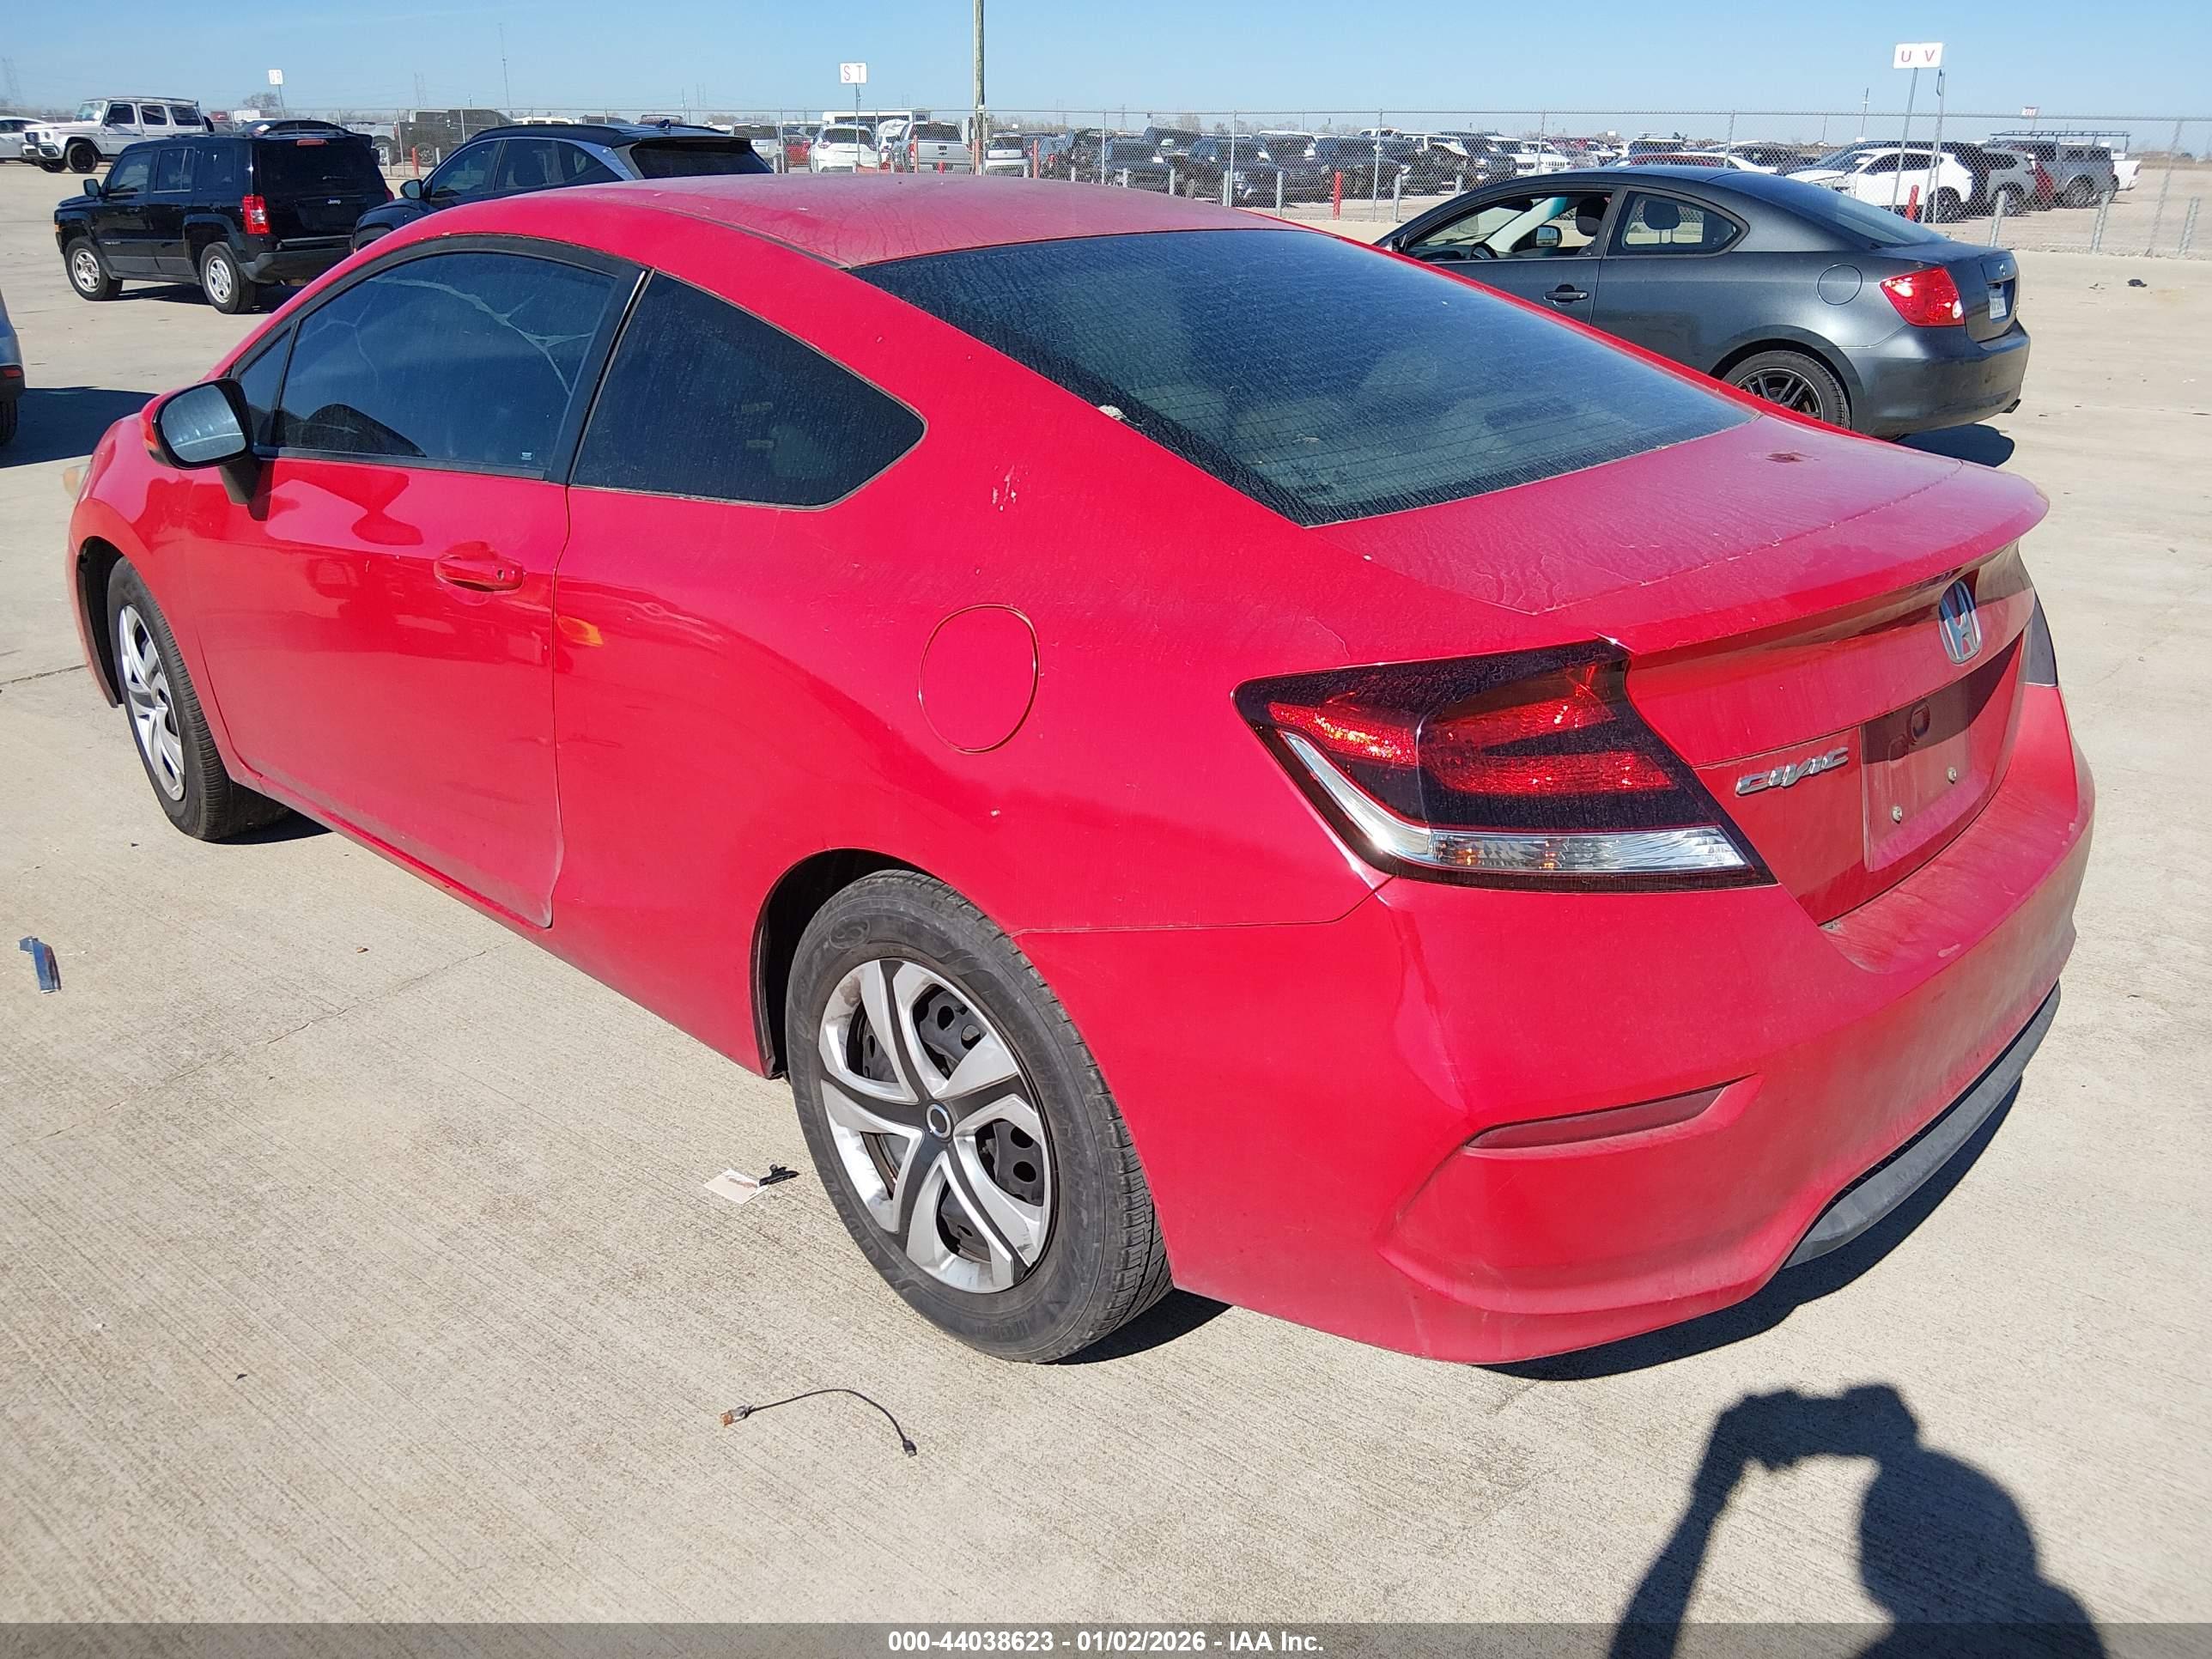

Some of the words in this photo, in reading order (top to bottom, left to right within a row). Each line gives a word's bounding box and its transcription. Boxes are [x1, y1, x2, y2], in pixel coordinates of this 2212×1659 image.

[1900, 50, 1912, 63] U
[1924, 49, 1936, 63] V
[843, 64, 851, 82] S
[855, 64, 864, 83] T
[1735, 745, 1850, 797] CIVIC
